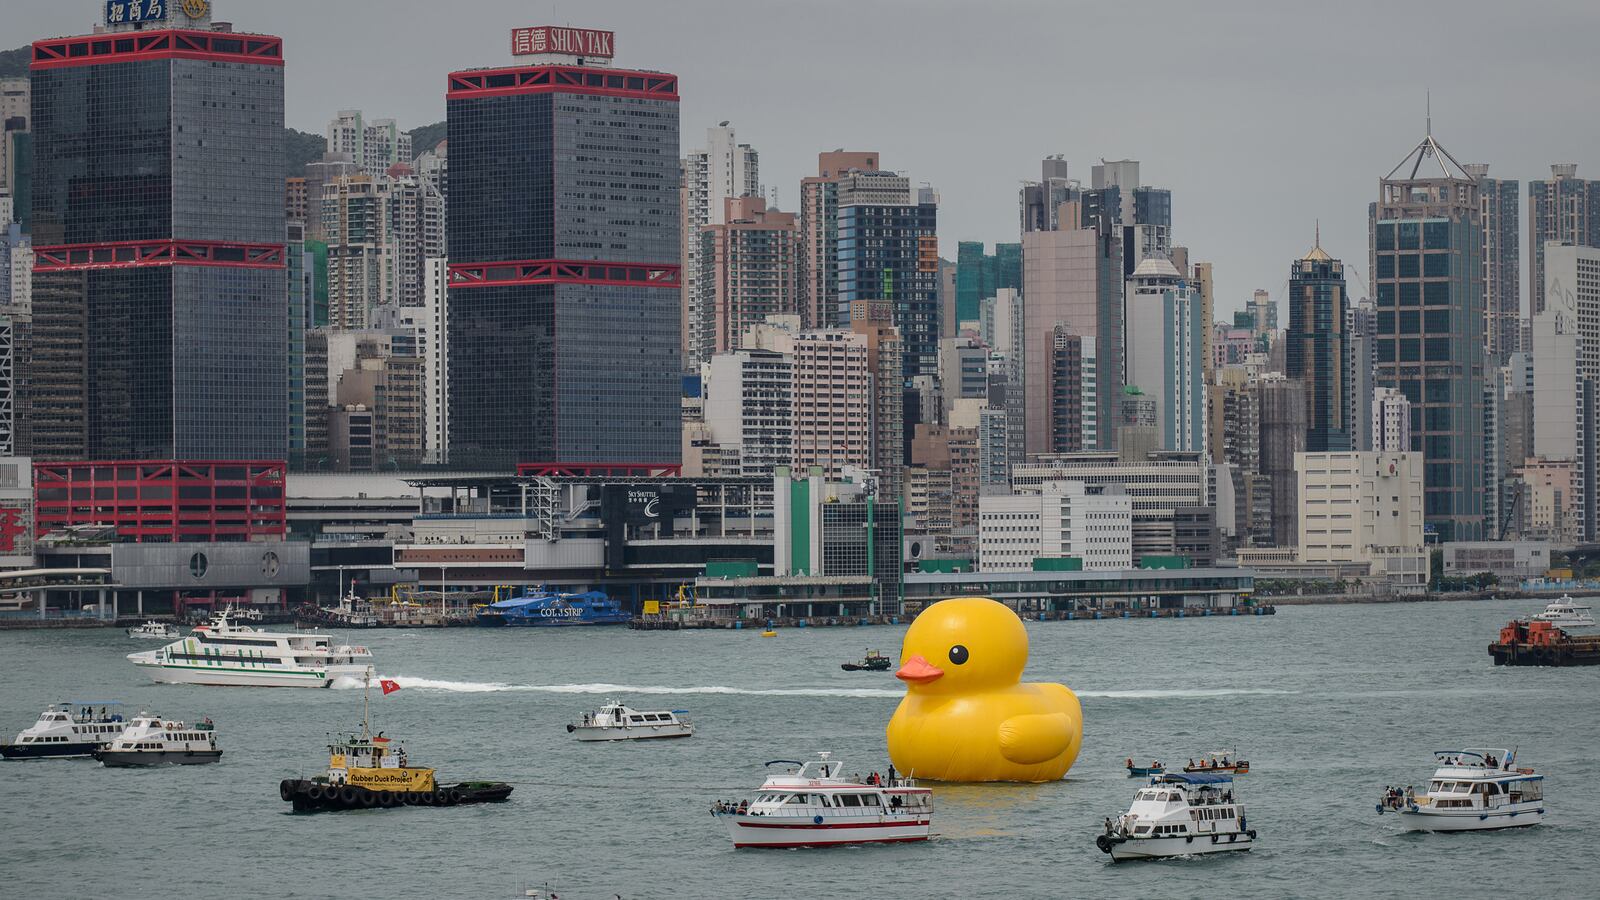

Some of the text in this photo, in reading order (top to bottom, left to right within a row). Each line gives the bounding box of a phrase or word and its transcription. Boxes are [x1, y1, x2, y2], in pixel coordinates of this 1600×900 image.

[109, 0, 162, 22] 招商局
[515, 29, 546, 53] 信德
[551, 28, 611, 55] SHUN TAK
[628, 490, 656, 498] SKY SHUTTLE
[564, 607, 584, 617] STRIP
[351, 774, 413, 784] Rubber Duck Project
